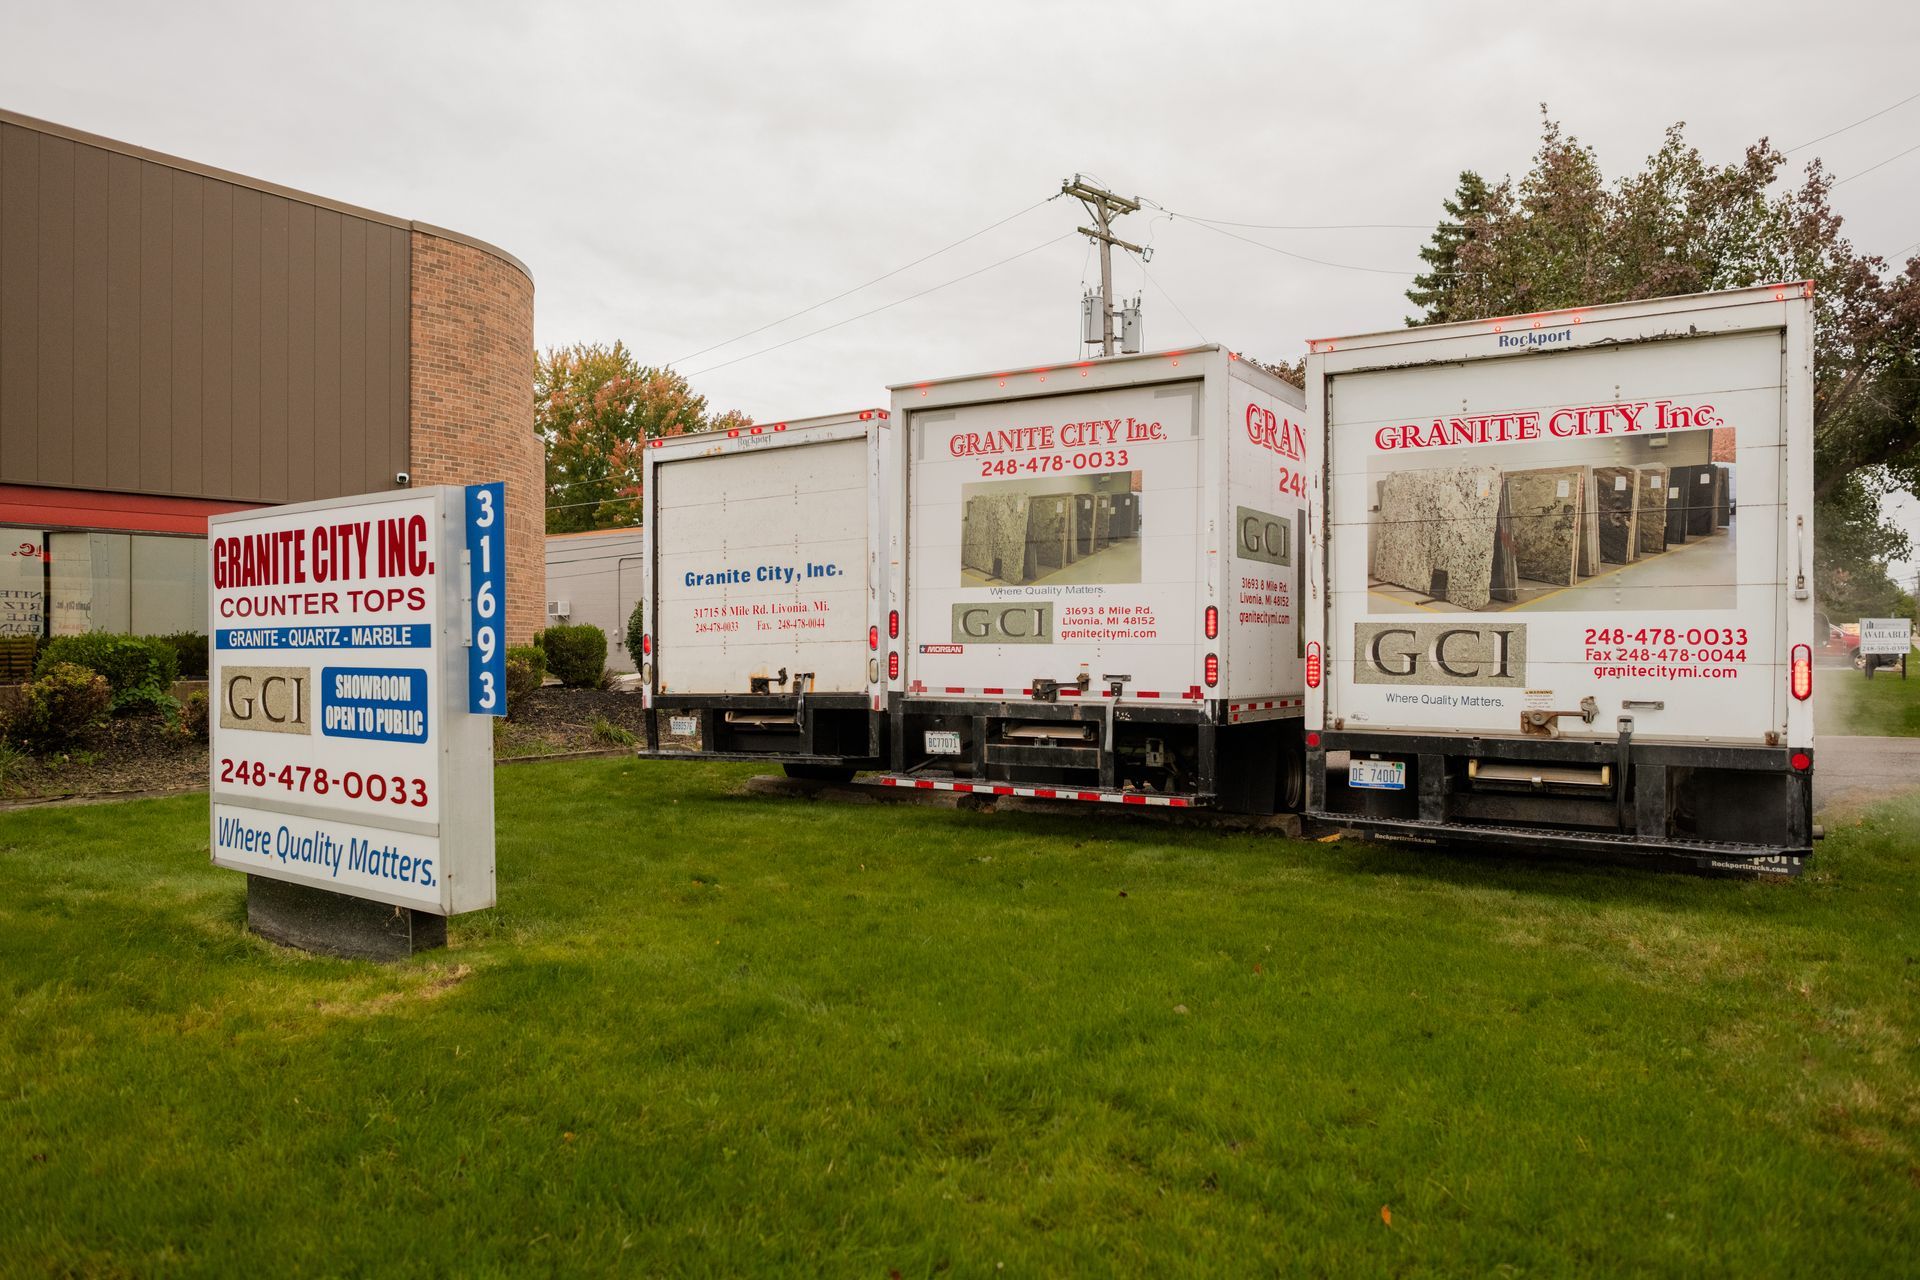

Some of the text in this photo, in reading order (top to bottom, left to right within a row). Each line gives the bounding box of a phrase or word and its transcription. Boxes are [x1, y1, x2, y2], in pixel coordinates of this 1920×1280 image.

[1499, 329, 1571, 347] Rockport
[1246, 403, 1306, 462] GRAN
[1375, 401, 1724, 450] GRANITE CITY Inc.
[950, 417, 1167, 457] GRANITE CITY Inc.
[981, 450, 1128, 477] 248-478-0033
[1241, 517, 1287, 557] GCI
[214, 515, 434, 589] GRANITE CITY INC.
[685, 563, 843, 586] Granite City, Inc.
[990, 586, 1106, 596] Where Quality Matters.
[1242, 577, 1288, 593] 31693 8 Mile Rd.
[221, 587, 425, 617] COUNTER TOPS
[476, 490, 496, 709] 31693
[1273, 596, 1289, 608] 48152
[693, 607, 719, 618] 31715
[722, 607, 726, 617] 8
[730, 605, 749, 616] Mile
[752, 604, 768, 615] Rd.
[813, 601, 829, 612] Mi.
[1066, 607, 1094, 615] 31693
[1109, 606, 1131, 614] Mile
[1136, 606, 1152, 614] Rd.
[1240, 611, 1290, 627] granitecitymi.com
[696, 622, 739, 632] 248-478-0033
[778, 618, 825, 629] 248-478-0044
[959, 608, 1045, 637] GCI
[1107, 617, 1118, 625] MI
[1123, 616, 1155, 625] 48152
[229, 629, 278, 647] GRANITE
[289, 628, 340, 646] QUARTZ
[352, 626, 411, 645] MARBLE
[1062, 628, 1156, 640] granitecitymi.com
[1585, 628, 1748, 645] 248-478-0033
[1864, 631, 1909, 639] AVAILABLE
[1365, 629, 1514, 678] GCI
[1586, 648, 1746, 662] Fax 248-478-0044
[1594, 665, 1737, 680] granitecitymi.com
[336, 674, 411, 701] SHOWROOM
[225, 675, 305, 724] GCI
[1386, 692, 1504, 707] Where Quality Matters.
[325, 705, 423, 736] OPEN TO PUBLIC
[221, 759, 428, 807] 248-478-0033
[1353, 768, 1401, 783] DE 74007
[219, 816, 436, 887] Where Quality Matters.
[1711, 860, 1788, 873] Rockporttrucks.com
